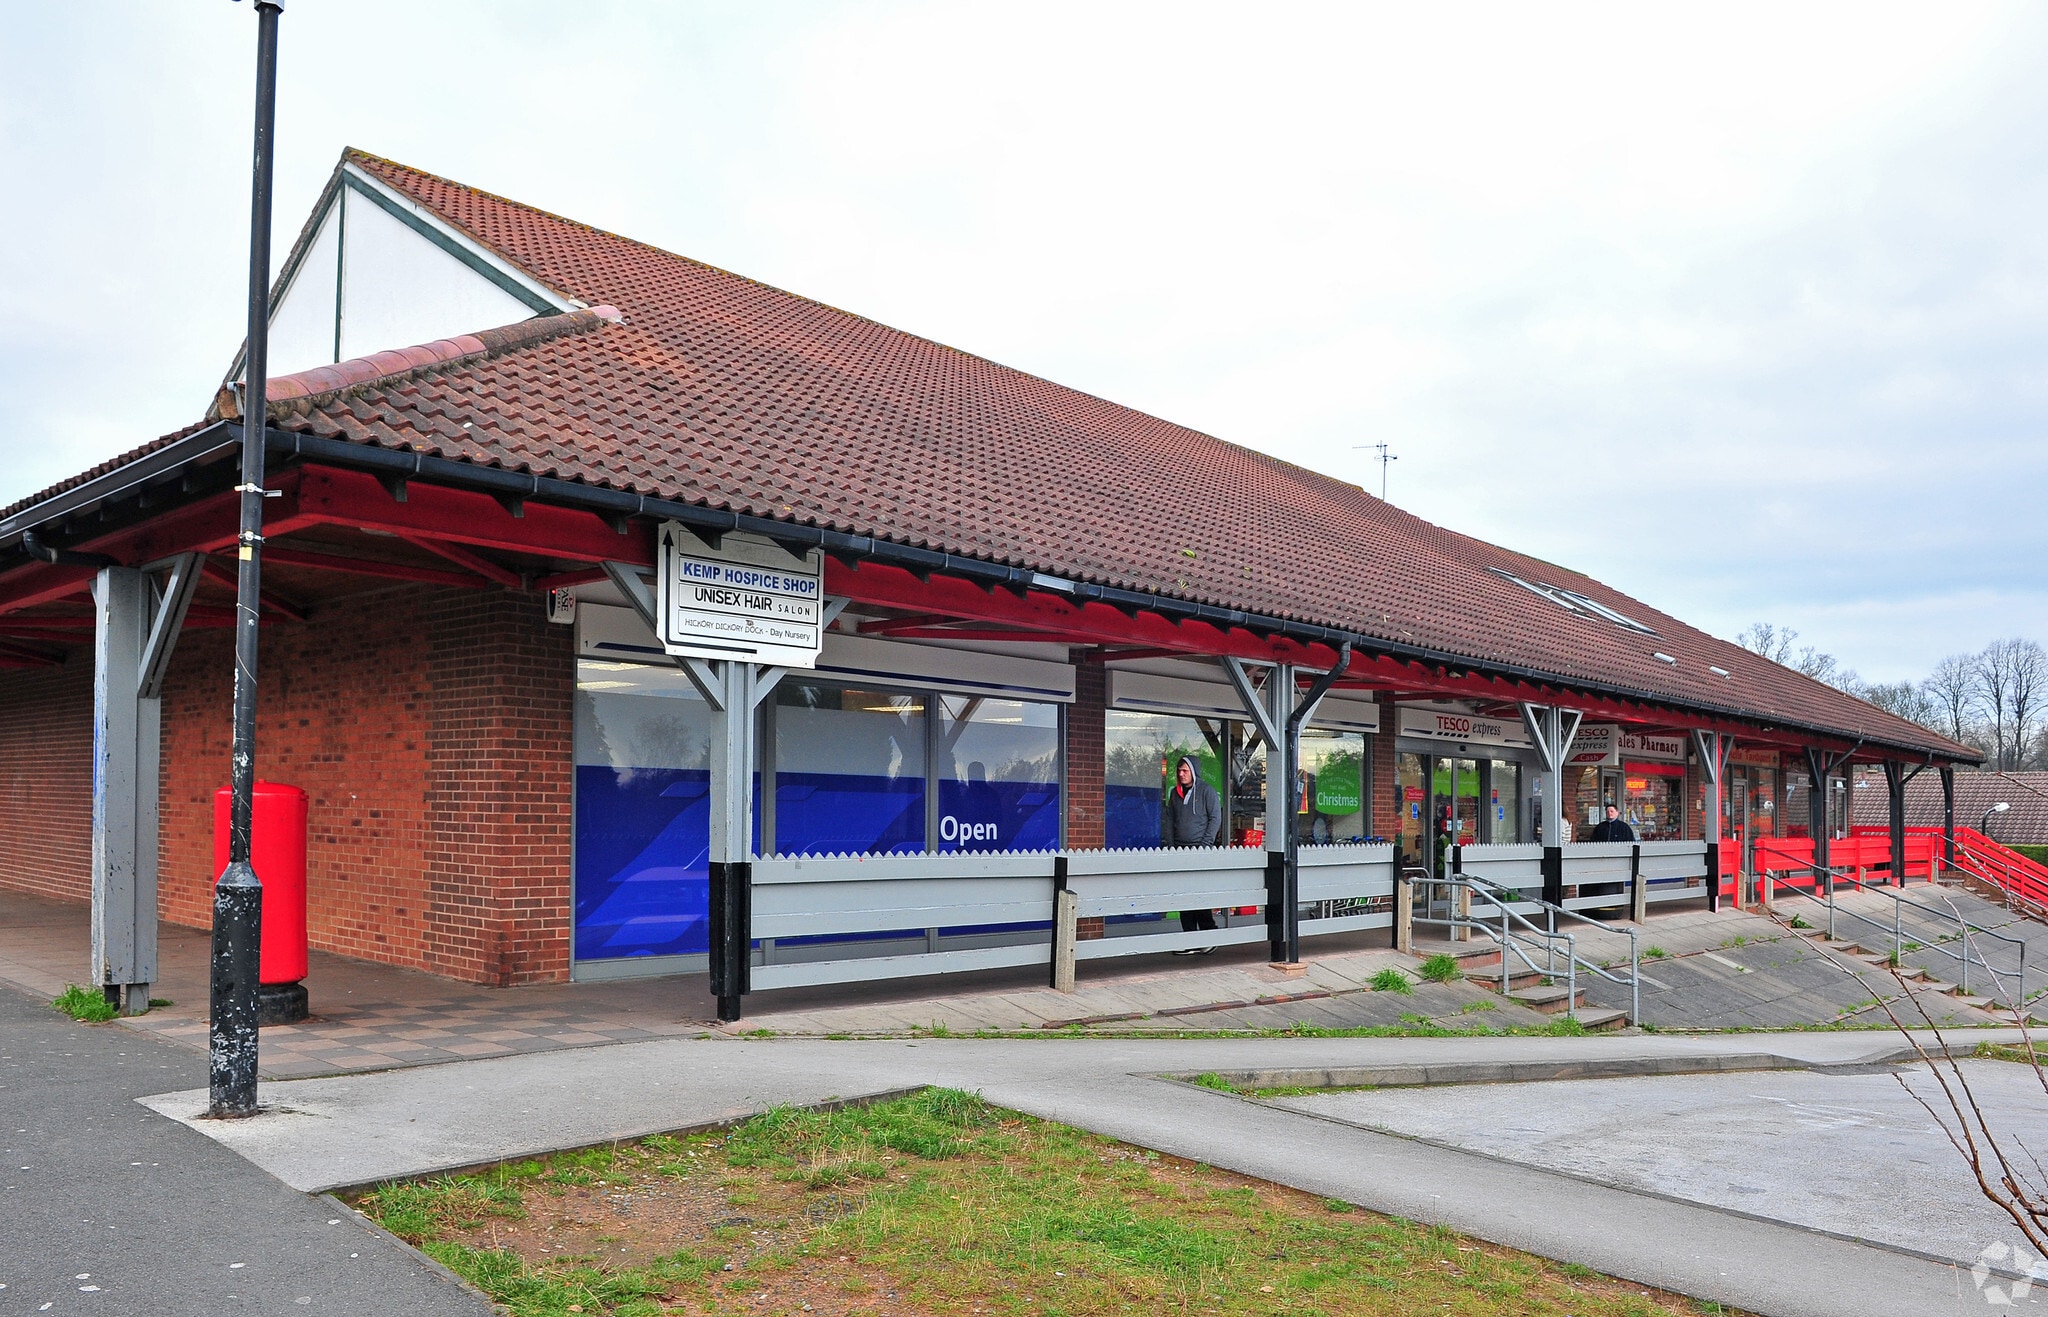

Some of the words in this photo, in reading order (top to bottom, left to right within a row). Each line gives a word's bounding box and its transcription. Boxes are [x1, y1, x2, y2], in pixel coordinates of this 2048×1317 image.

[684, 561, 721, 580] KEMP
[725, 568, 780, 590] HOSPICE
[783, 579, 816, 594] SHOP
[695, 587, 741, 607] UNISEX
[744, 594, 773, 611] HAIR
[777, 604, 811, 616] SALON
[684, 617, 714, 629] HICKORY
[715, 622, 744, 633] DICKORY
[744, 624, 764, 635] DOCK
[769, 627, 783, 639] Day
[784, 630, 811, 642] Nursery
[1436, 715, 1470, 732] TESCO
[1472, 722, 1501, 738] express
[1577, 728, 1609, 737] ESCO
[1570, 741, 1608, 751] express
[1618, 734, 1636, 749] ales
[1640, 735, 1679, 756] Pharmacy
[1580, 753, 1599, 762] Cash
[1317, 791, 1359, 807] Christmas
[940, 815, 998, 847] Open
